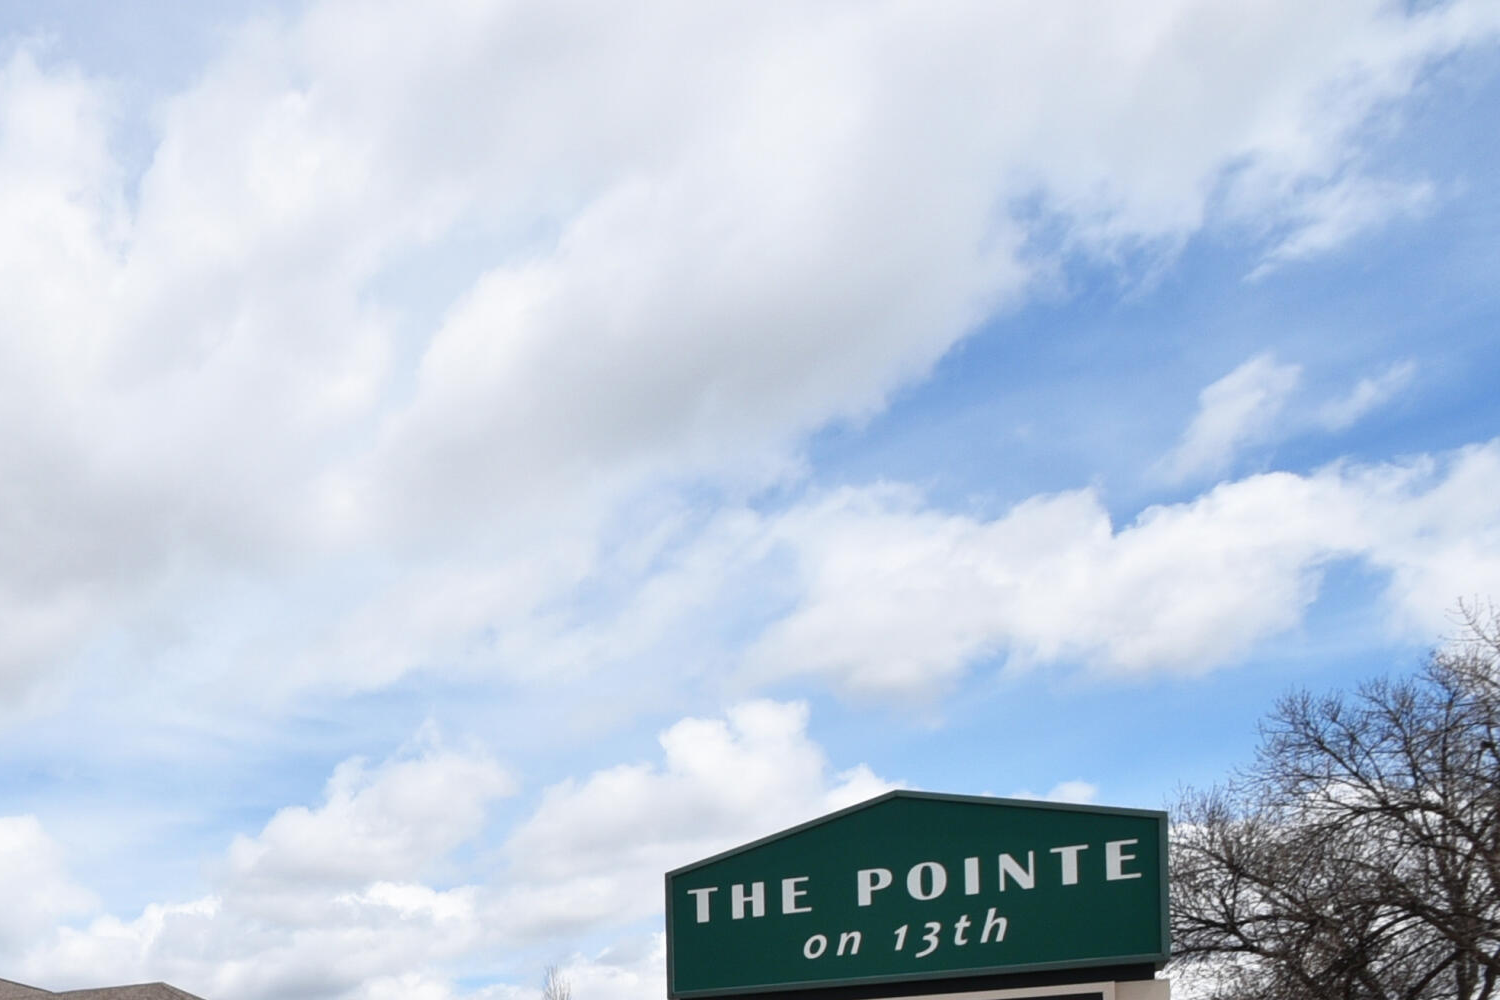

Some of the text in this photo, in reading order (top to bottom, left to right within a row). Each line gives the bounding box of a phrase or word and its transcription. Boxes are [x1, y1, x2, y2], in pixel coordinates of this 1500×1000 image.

[687, 838, 1143, 923] THE POINTE
[803, 907, 1008, 960] on 13th
